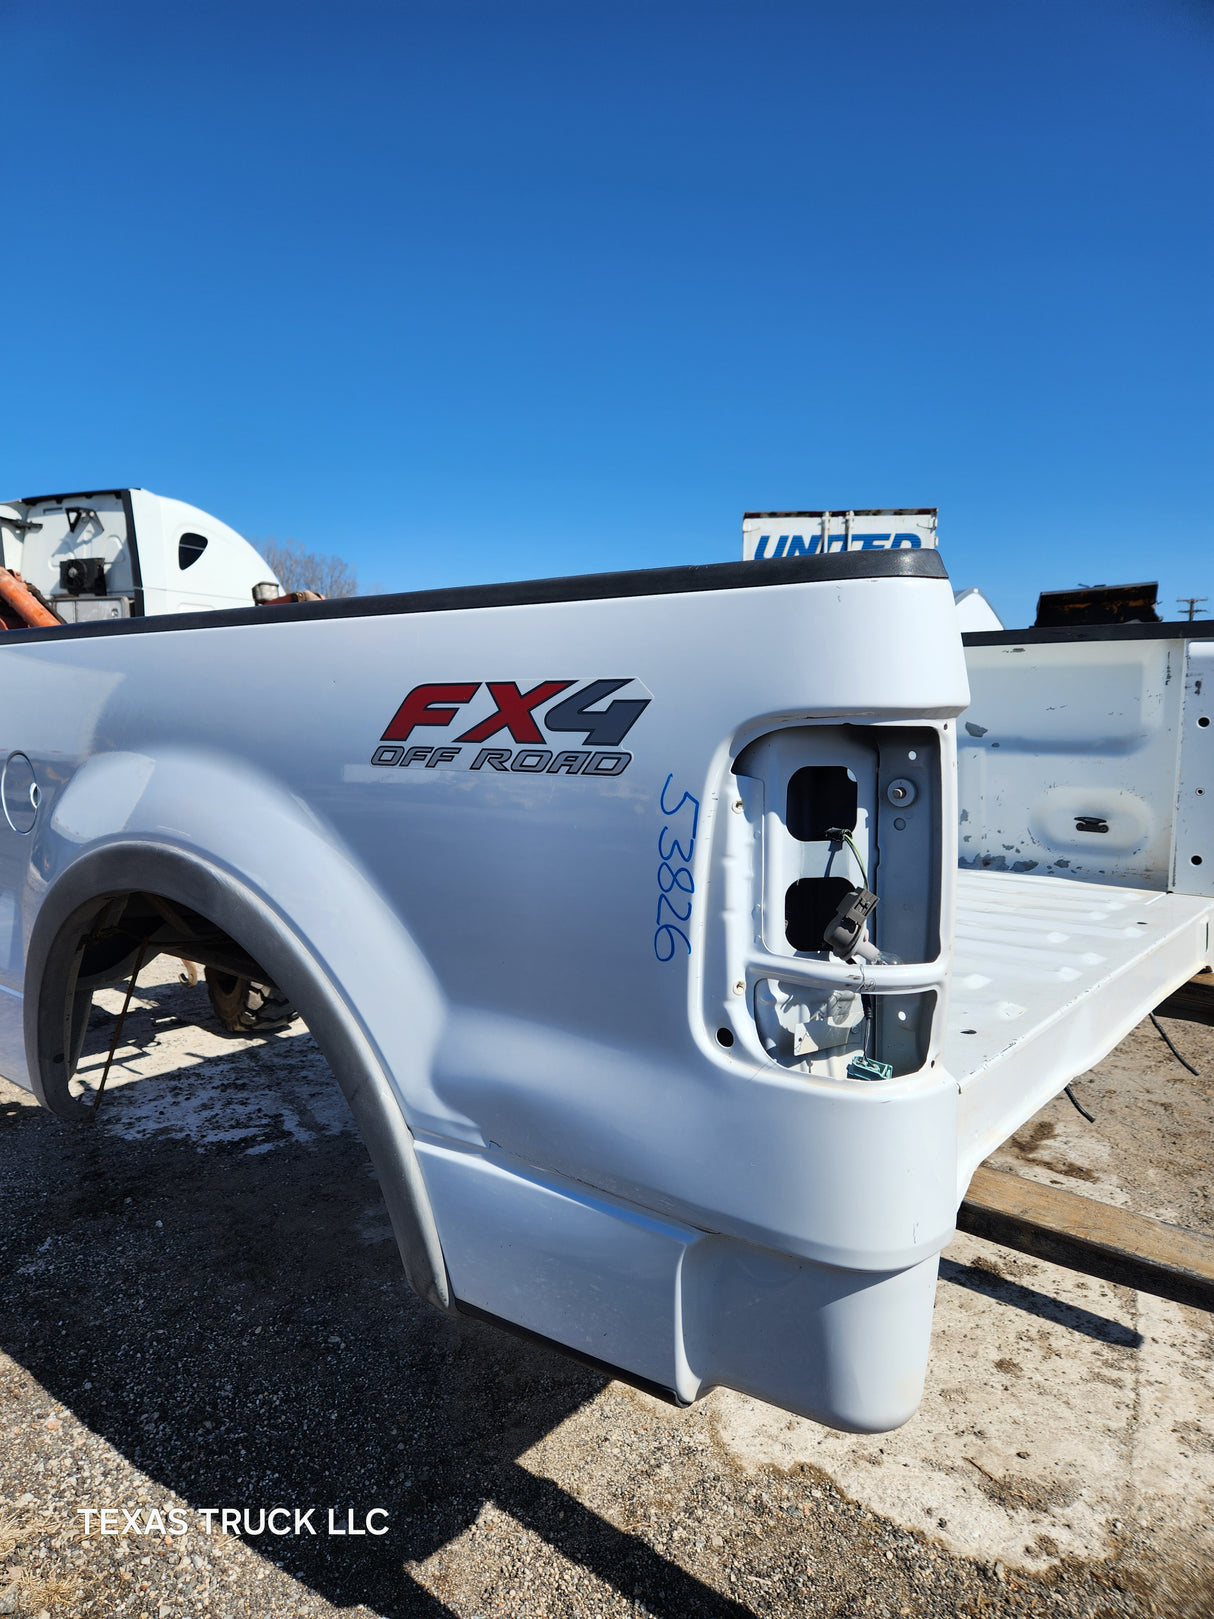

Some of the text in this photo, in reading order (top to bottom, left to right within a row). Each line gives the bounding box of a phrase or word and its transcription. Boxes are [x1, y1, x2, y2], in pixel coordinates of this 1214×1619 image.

[379, 678, 652, 746] FX4
[370, 745, 632, 777] OFF ROAD
[654, 773, 700, 962] 53826
